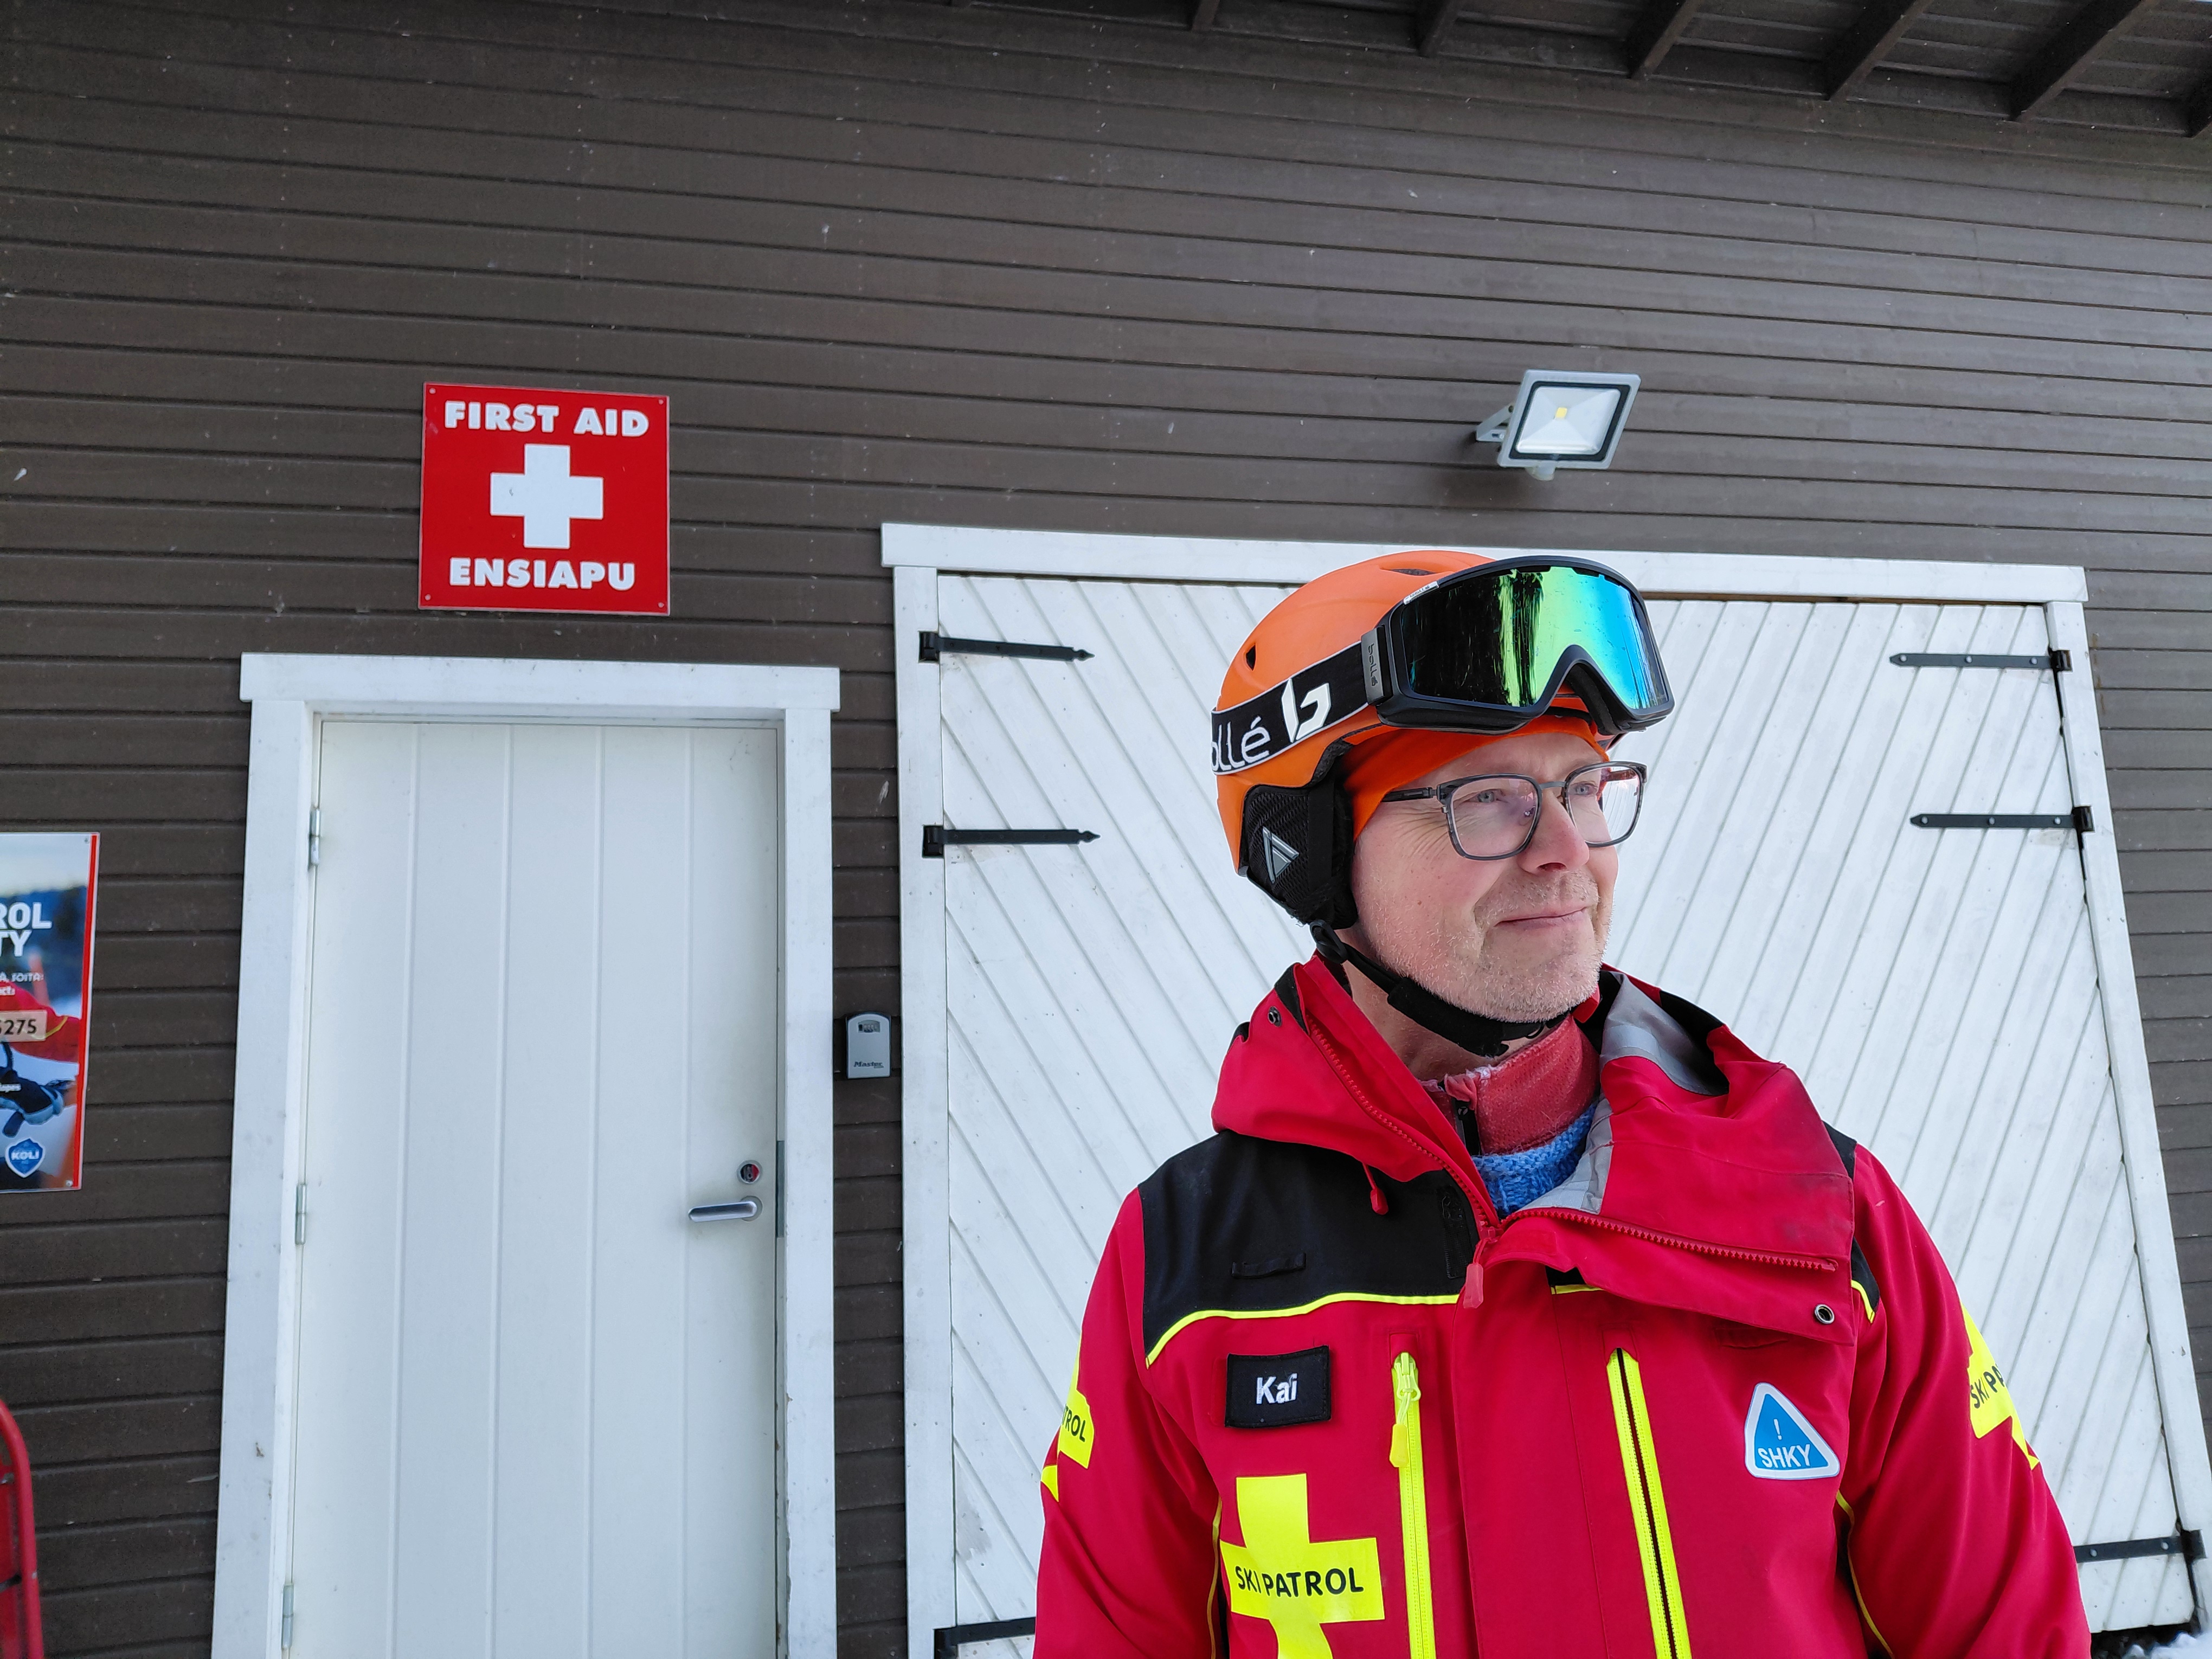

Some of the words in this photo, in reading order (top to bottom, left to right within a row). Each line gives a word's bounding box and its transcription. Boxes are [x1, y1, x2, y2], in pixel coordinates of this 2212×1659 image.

[444, 400, 559, 433] FIRST
[573, 407, 649, 437] AID
[449, 557, 635, 591] ENSIAPU
[0, 1019, 37, 1035] 275
[11, 1150, 40, 1161] KOLI
[1256, 1373, 1297, 1404] Kai
[1983, 1363, 2005, 1393] PA
[1062, 1403, 1085, 1443] TROL
[1758, 1444, 1810, 1468] SHKY
[1235, 1566, 1261, 1594] SKI
[1262, 1567, 1364, 1598] PATROL
